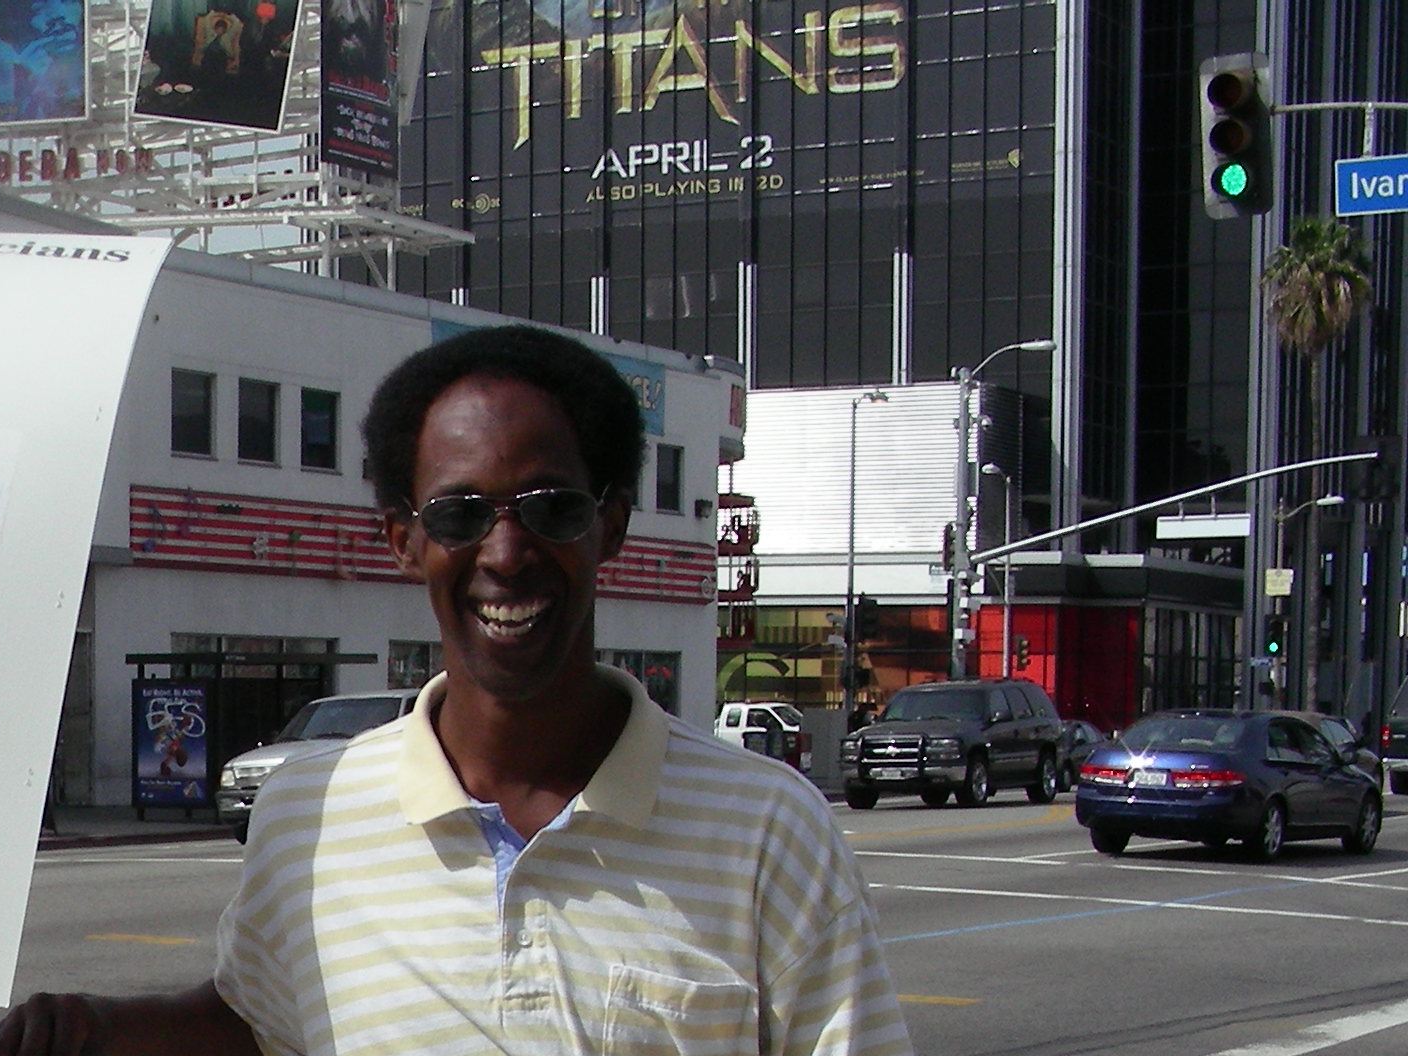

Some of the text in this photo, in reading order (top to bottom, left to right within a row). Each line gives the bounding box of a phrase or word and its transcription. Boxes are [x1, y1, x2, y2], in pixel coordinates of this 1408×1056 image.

[481, 4, 906, 150] TITANS
[591, 135, 774, 179] APRIL 2
[586, 186, 636, 203] ALSO
[638, 178, 722, 199] PLAYING
[1351, 171, 1408, 200] Ivar
